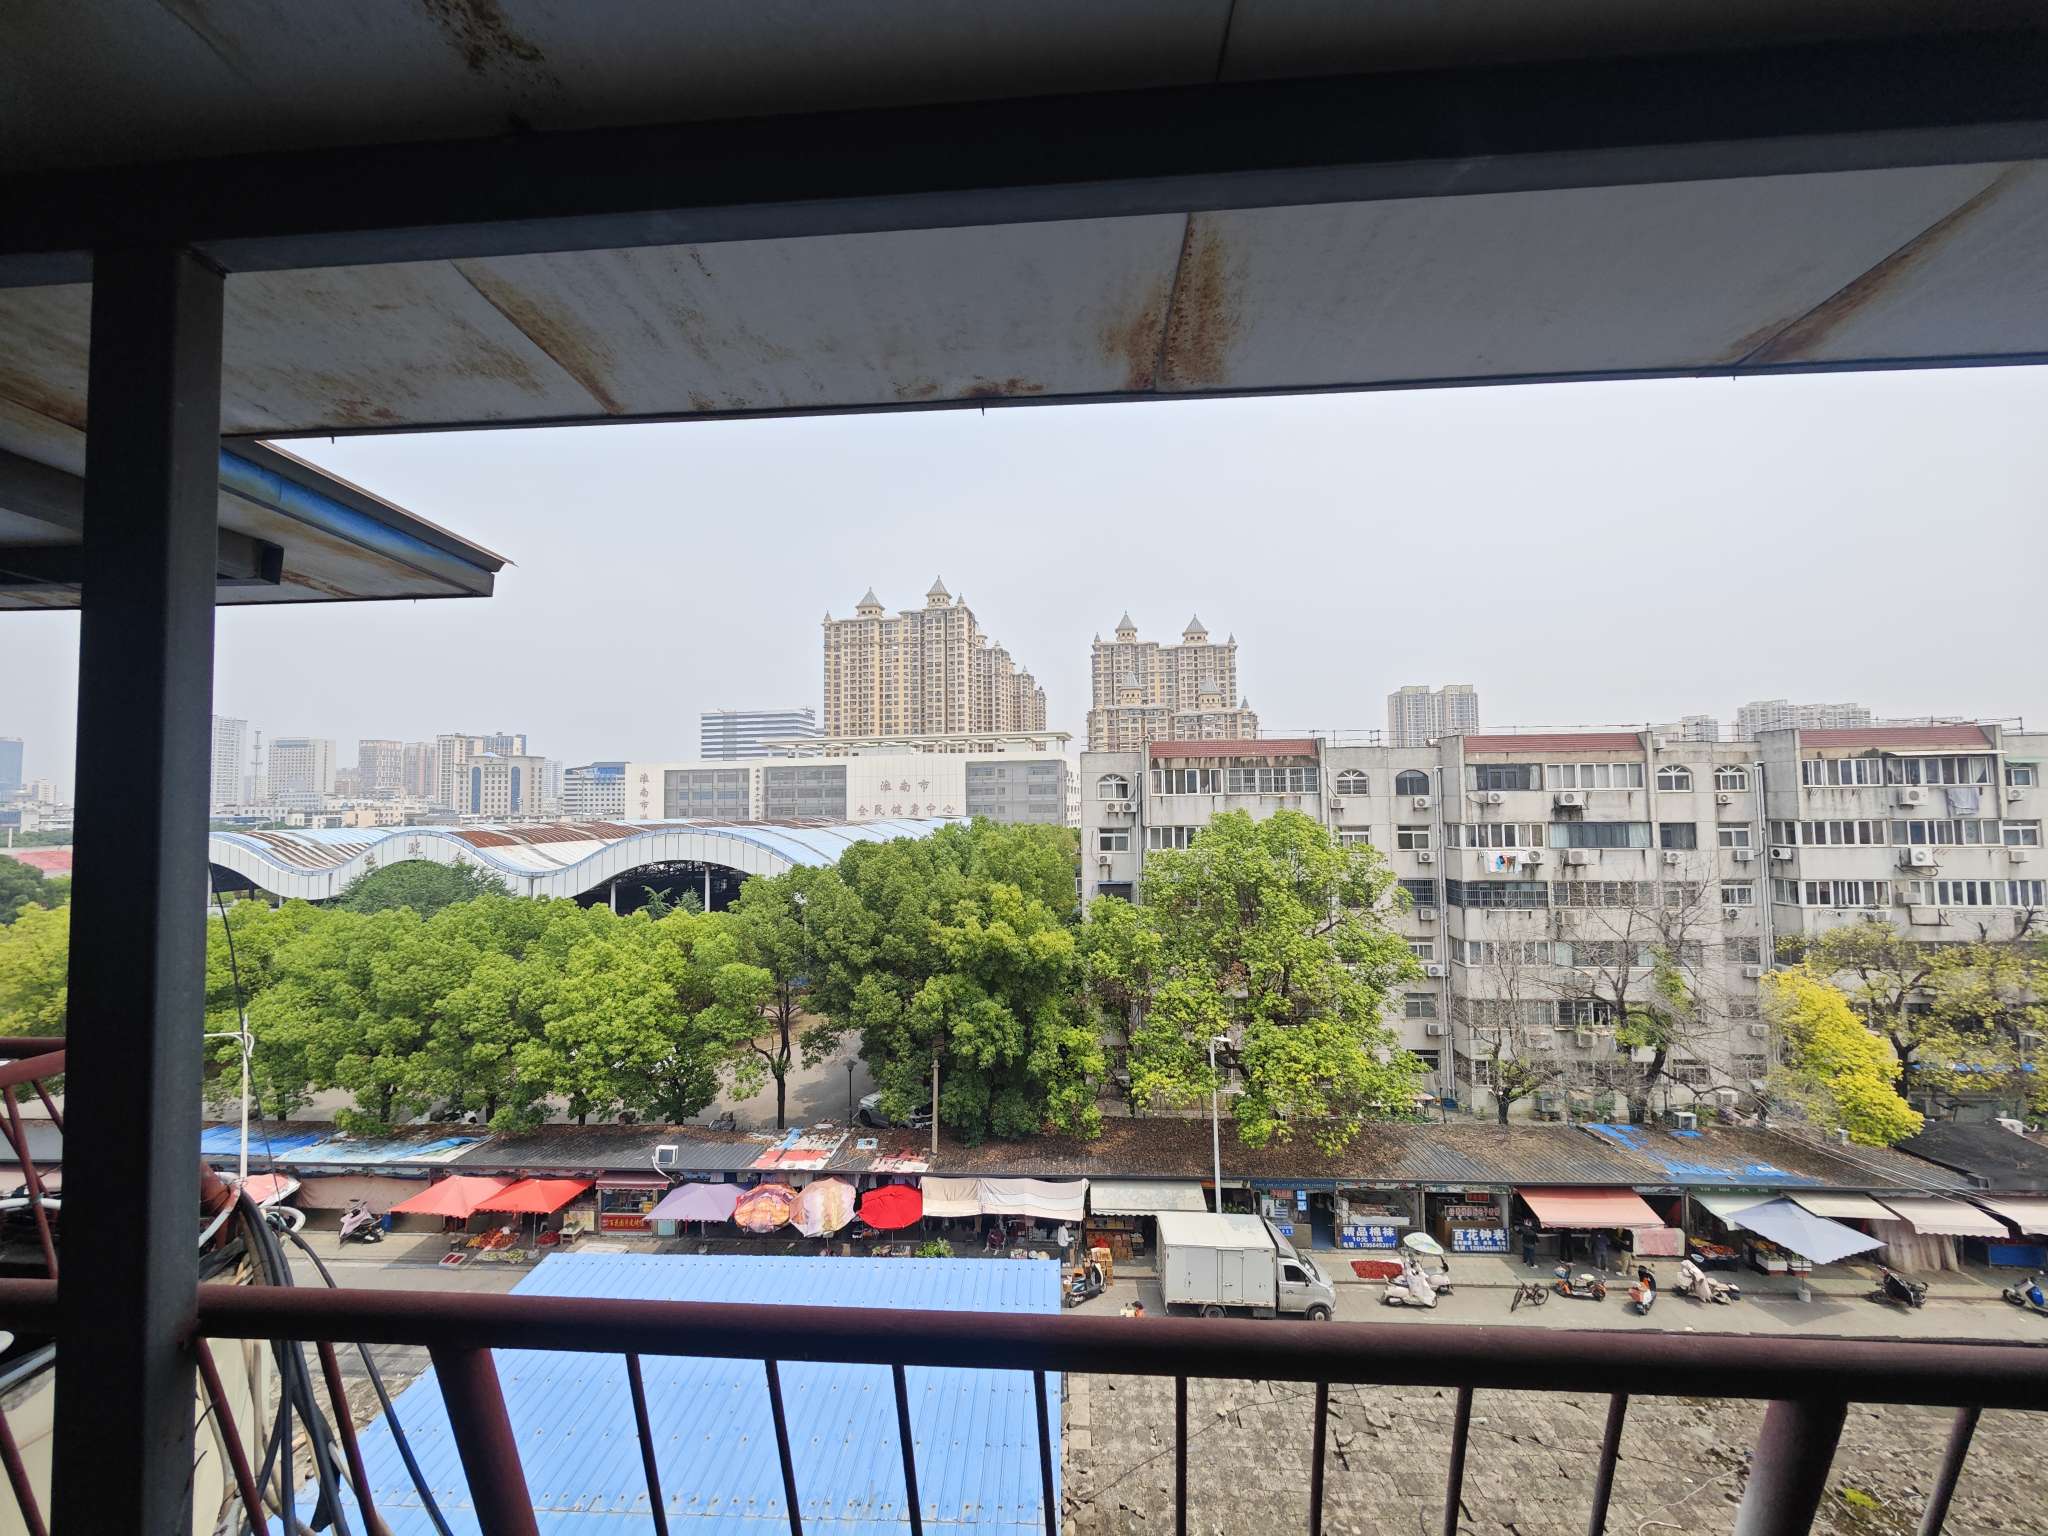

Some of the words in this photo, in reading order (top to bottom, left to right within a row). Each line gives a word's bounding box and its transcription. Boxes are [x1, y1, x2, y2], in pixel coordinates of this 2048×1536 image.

[880, 779, 931, 793] 淮南市
[857, 802, 955, 816] 全民健身中心
